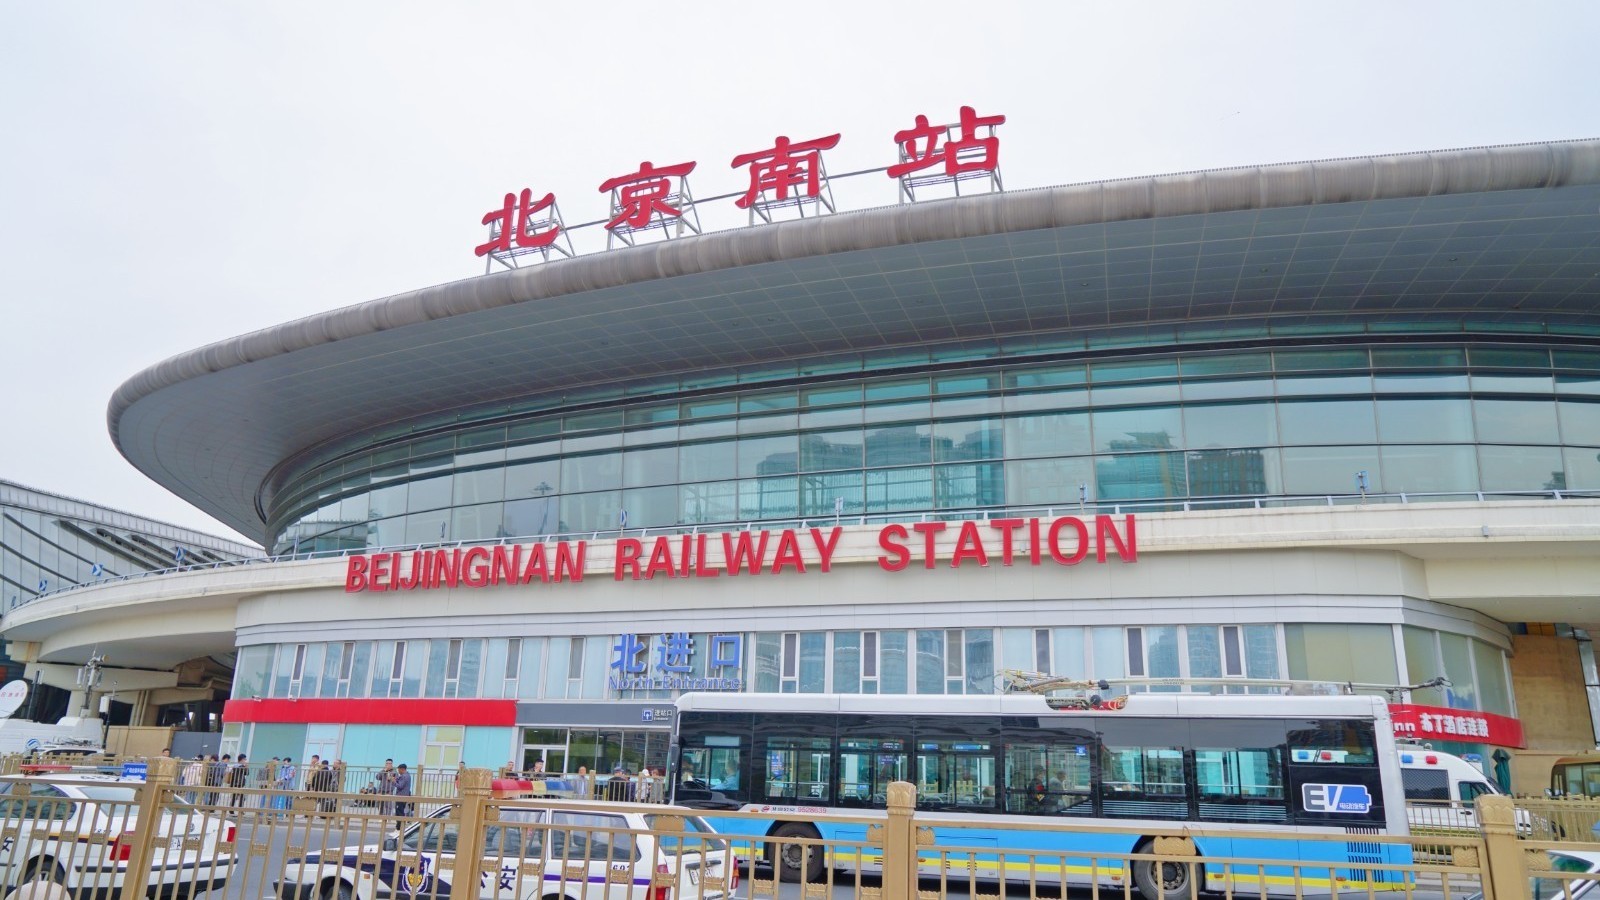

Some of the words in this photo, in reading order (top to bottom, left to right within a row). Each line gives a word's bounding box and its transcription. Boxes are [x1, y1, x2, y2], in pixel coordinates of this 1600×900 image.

[474, 105, 1006, 257] 北京南站
[346, 540, 586, 594] BEIJINGNAN
[614, 526, 842, 582] RAILWAY
[877, 514, 1138, 573] STATION
[610, 632, 742, 674] 北进口
[609, 675, 654, 690] North
[662, 675, 742, 690] Entrance
[1394, 721, 1416, 732] nn
[1303, 785, 1343, 812] EV
